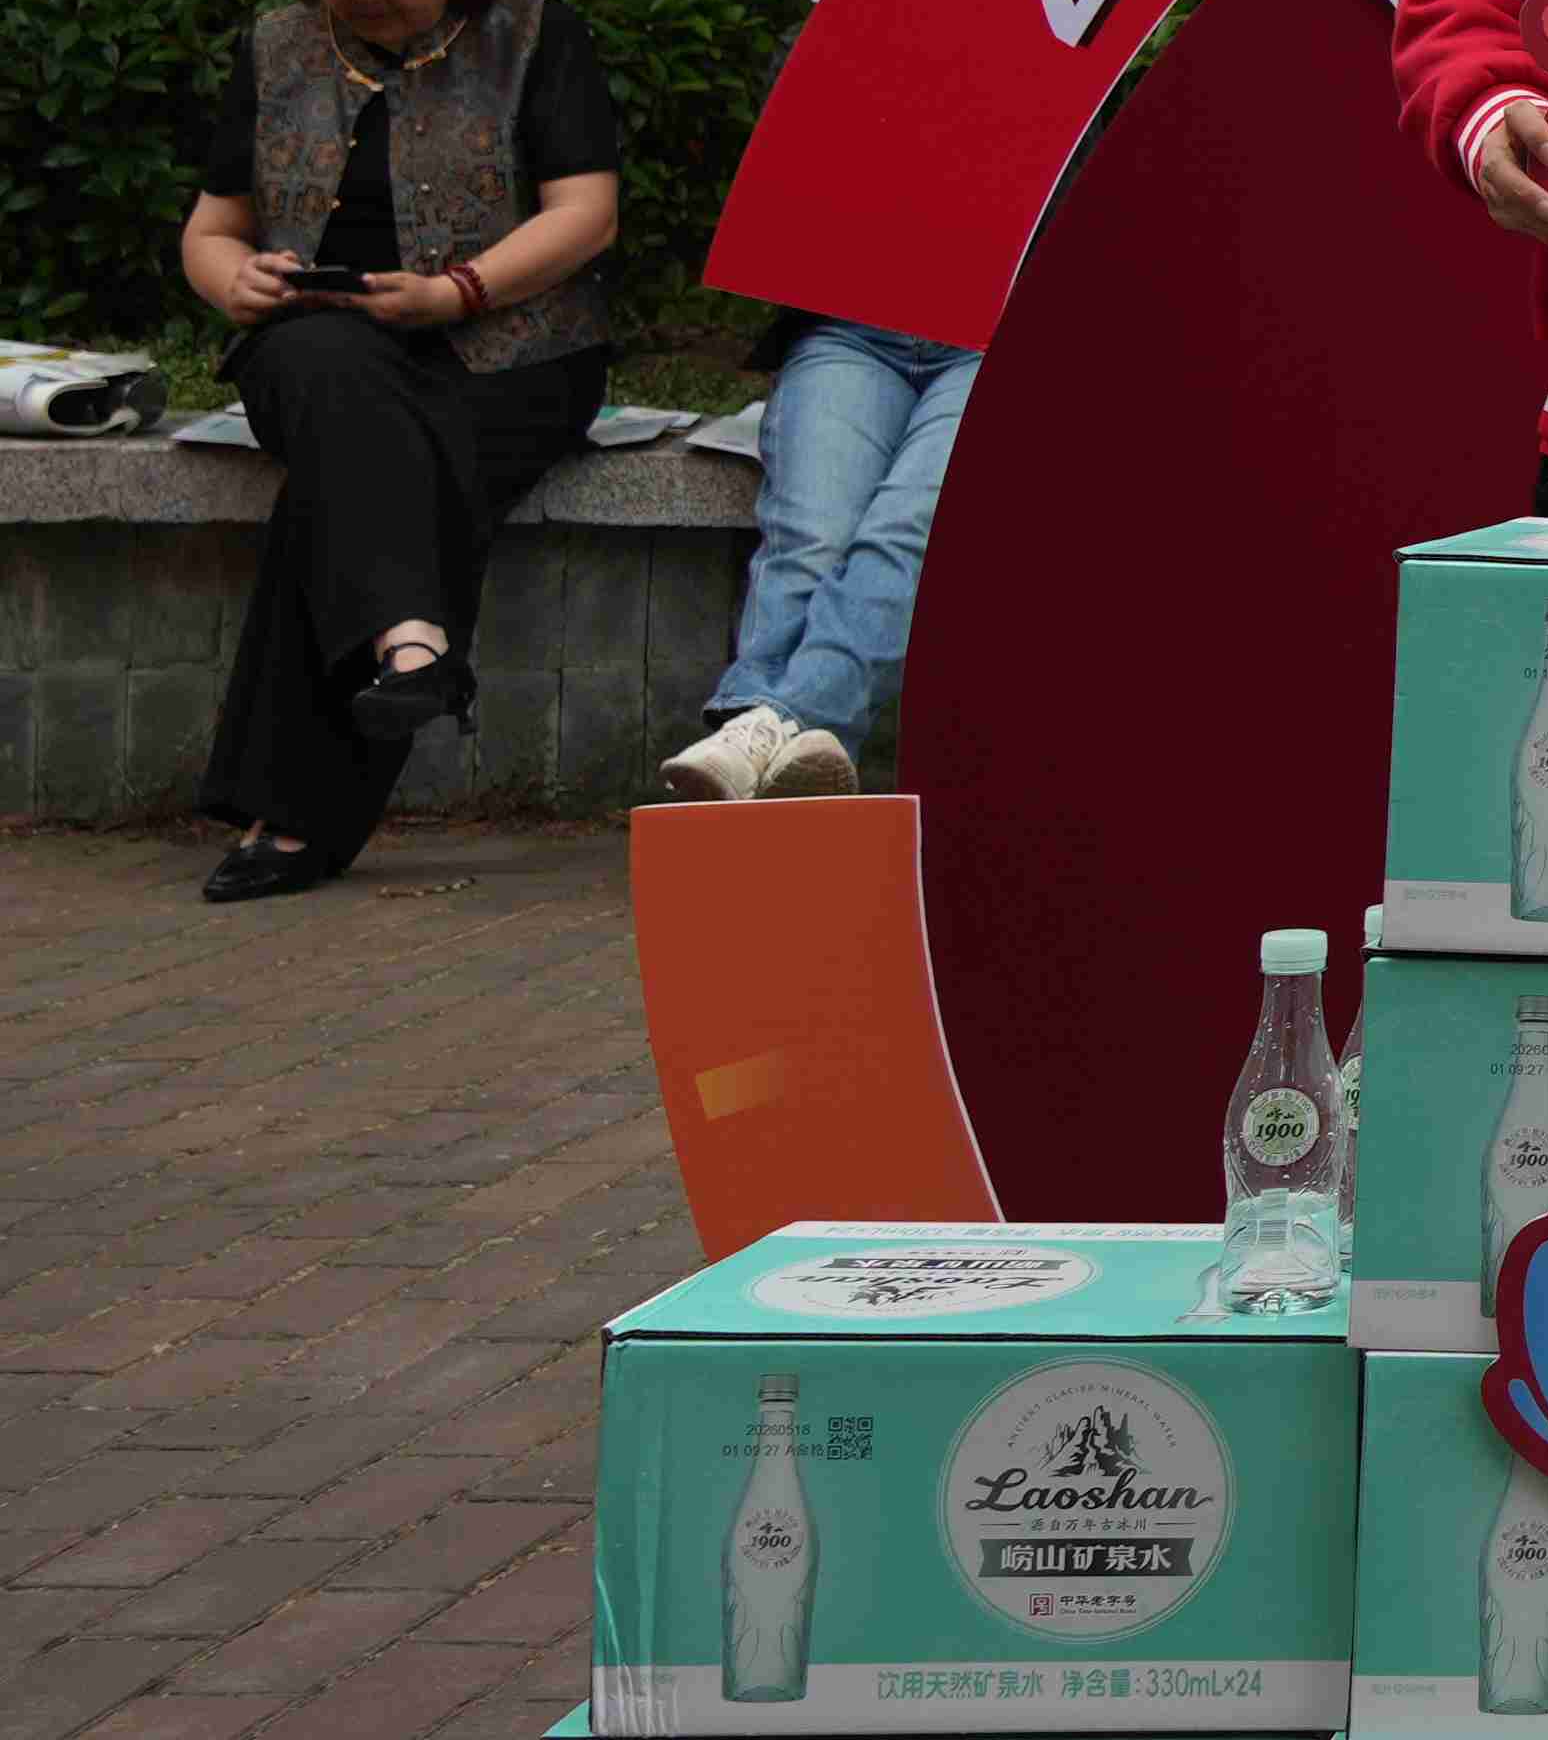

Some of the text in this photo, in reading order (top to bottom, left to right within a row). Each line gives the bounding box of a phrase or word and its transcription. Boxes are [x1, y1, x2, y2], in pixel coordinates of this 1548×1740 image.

[1256, 1123, 1305, 1141] 1900
[1512, 1154, 1548, 1168] 1900
[966, 1468, 1213, 1513] Laoshan
[753, 1534, 791, 1549] 1900
[1510, 1547, 1547, 1562] 1900
[877, 1669, 1043, 1701] 饮用天然矿泉水
